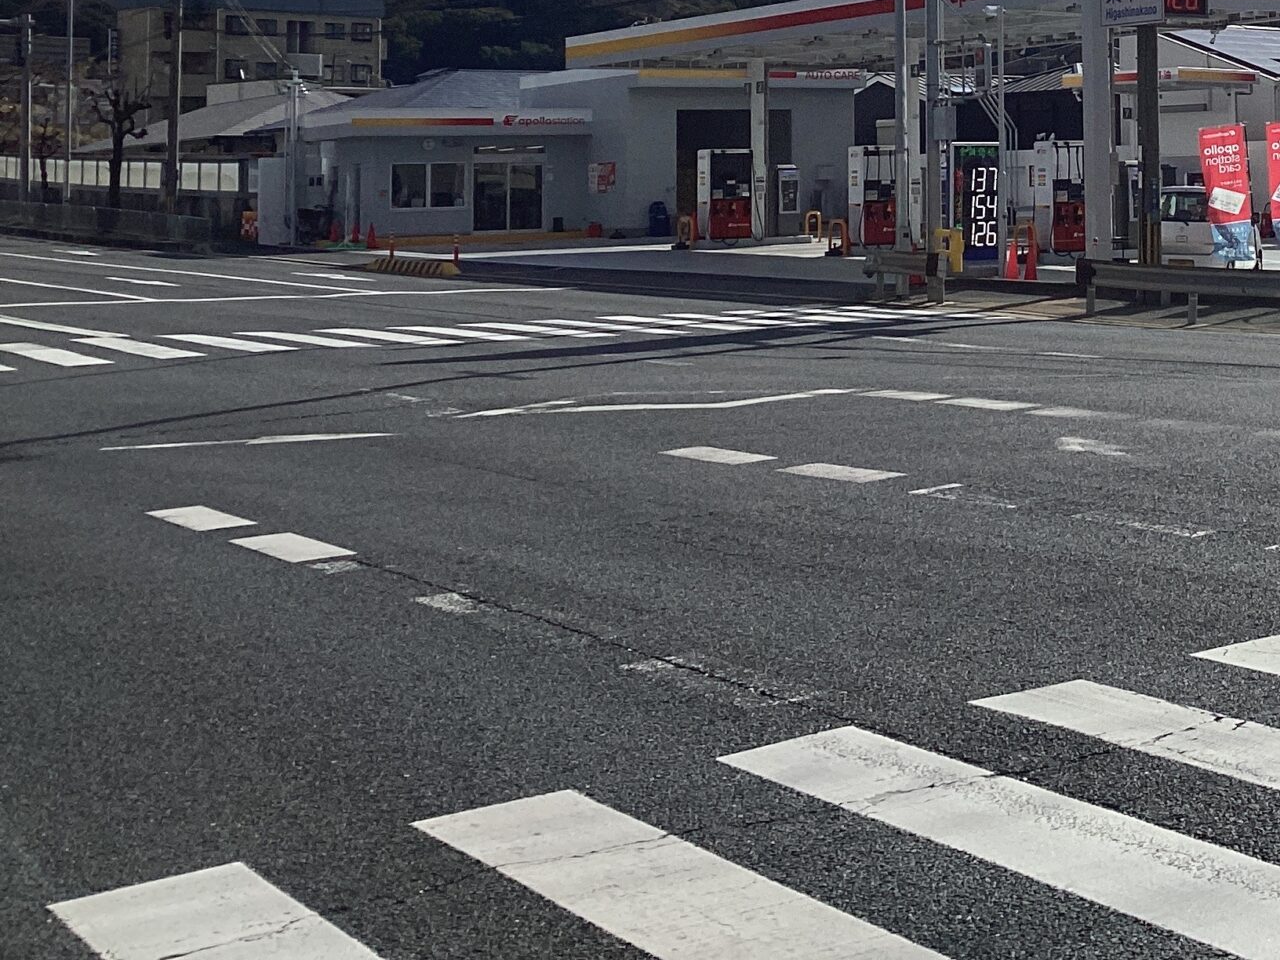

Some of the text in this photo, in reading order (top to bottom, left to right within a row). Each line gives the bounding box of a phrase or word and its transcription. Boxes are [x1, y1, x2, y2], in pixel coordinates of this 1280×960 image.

[805, 70, 860, 80] AUTO CARE
[518, 116, 585, 127] apollostation
[971, 167, 998, 192] 137
[971, 194, 998, 219] 154
[970, 221, 997, 246] 126
